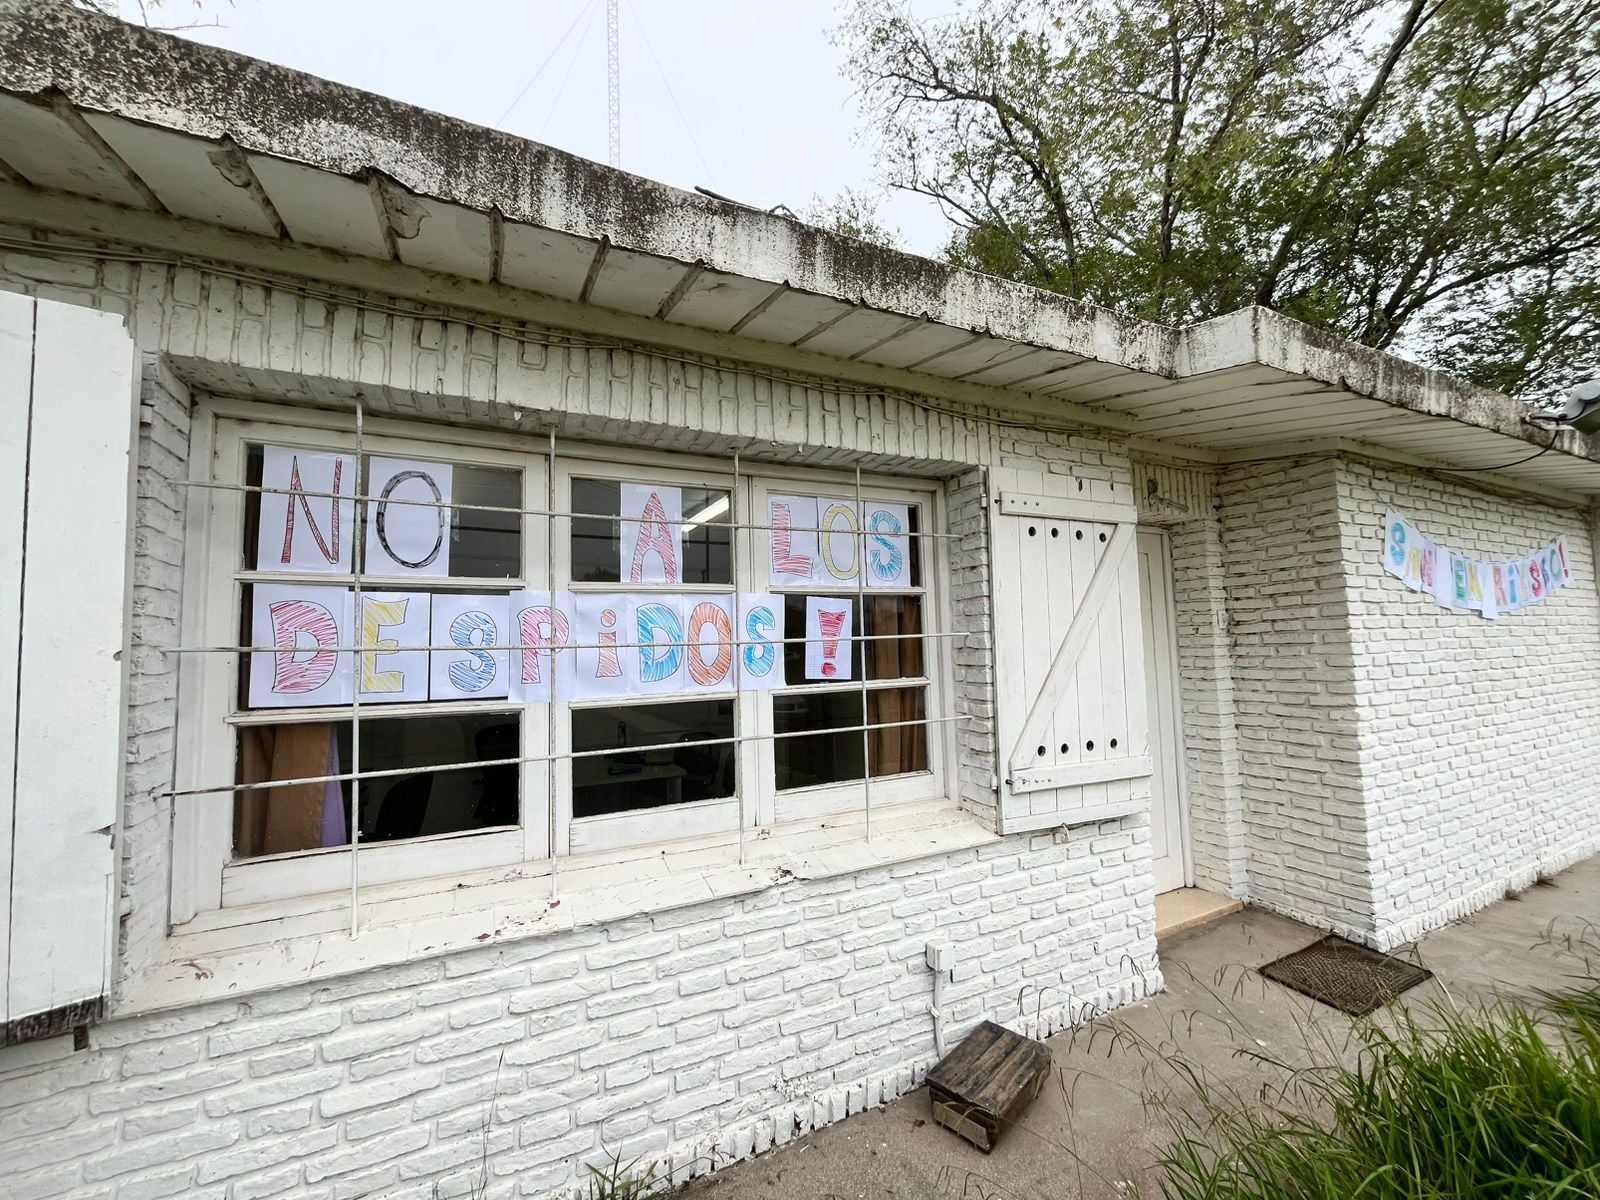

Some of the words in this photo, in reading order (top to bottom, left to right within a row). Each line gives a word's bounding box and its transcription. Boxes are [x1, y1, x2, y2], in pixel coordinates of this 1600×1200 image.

[281, 455, 445, 568] NO
[630, 490, 677, 583] A
[771, 502, 902, 581] LOS
